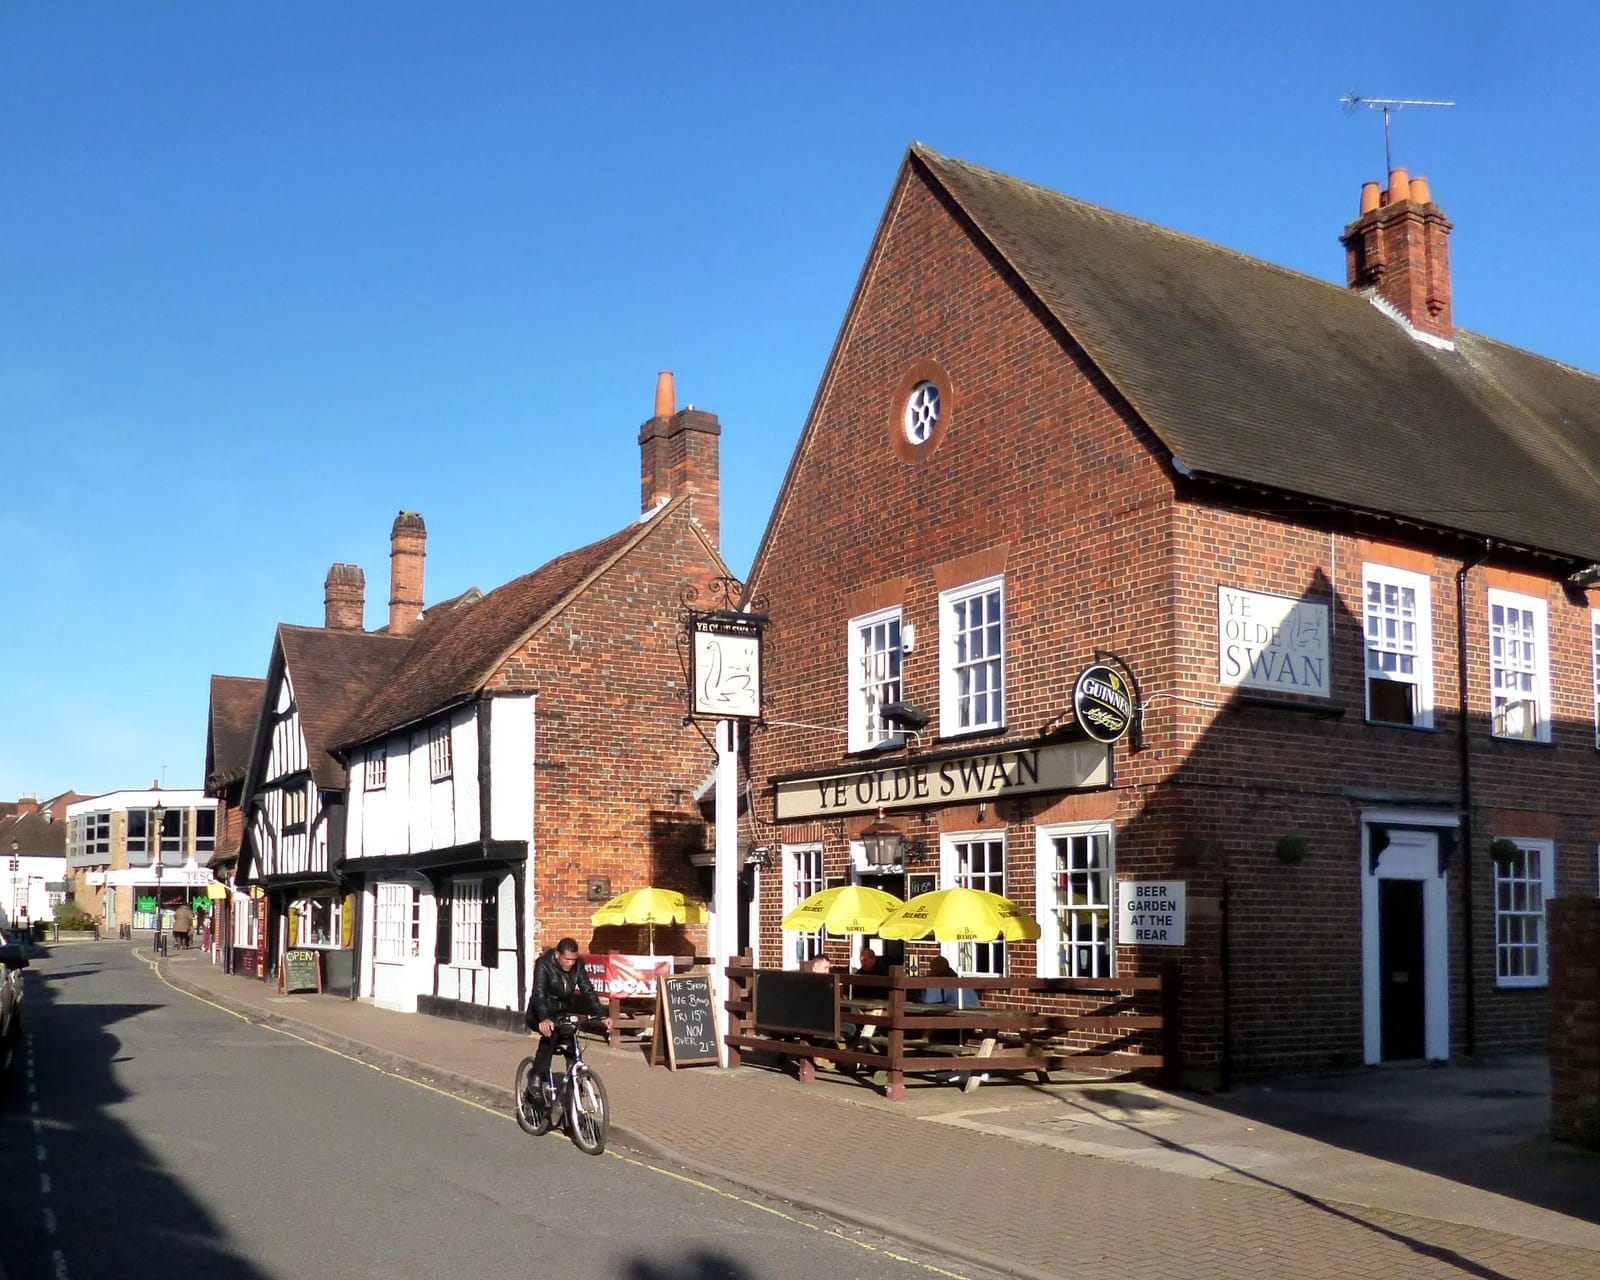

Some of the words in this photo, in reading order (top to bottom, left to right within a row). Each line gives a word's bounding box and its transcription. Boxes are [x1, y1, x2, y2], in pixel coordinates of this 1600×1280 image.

[1226, 594, 1251, 617] YE
[696, 622, 708, 631] YE
[1226, 619, 1280, 647] OLDE
[1226, 645, 1324, 688] SWAN
[818, 779, 847, 808] YE
[855, 766, 929, 806] OLDE
[939, 750, 1041, 796] SWAN
[1136, 886, 1167, 897] BEER
[1127, 901, 1176, 912] GARDEN
[1131, 915, 1145, 926] AT
[1149, 915, 1173, 926] THE
[1136, 930, 1167, 940] REAR
[286, 951, 313, 961] OPEN
[667, 980, 683, 991] THE
[686, 1024, 703, 1037] NOV
[674, 1036, 697, 1046] OVER
